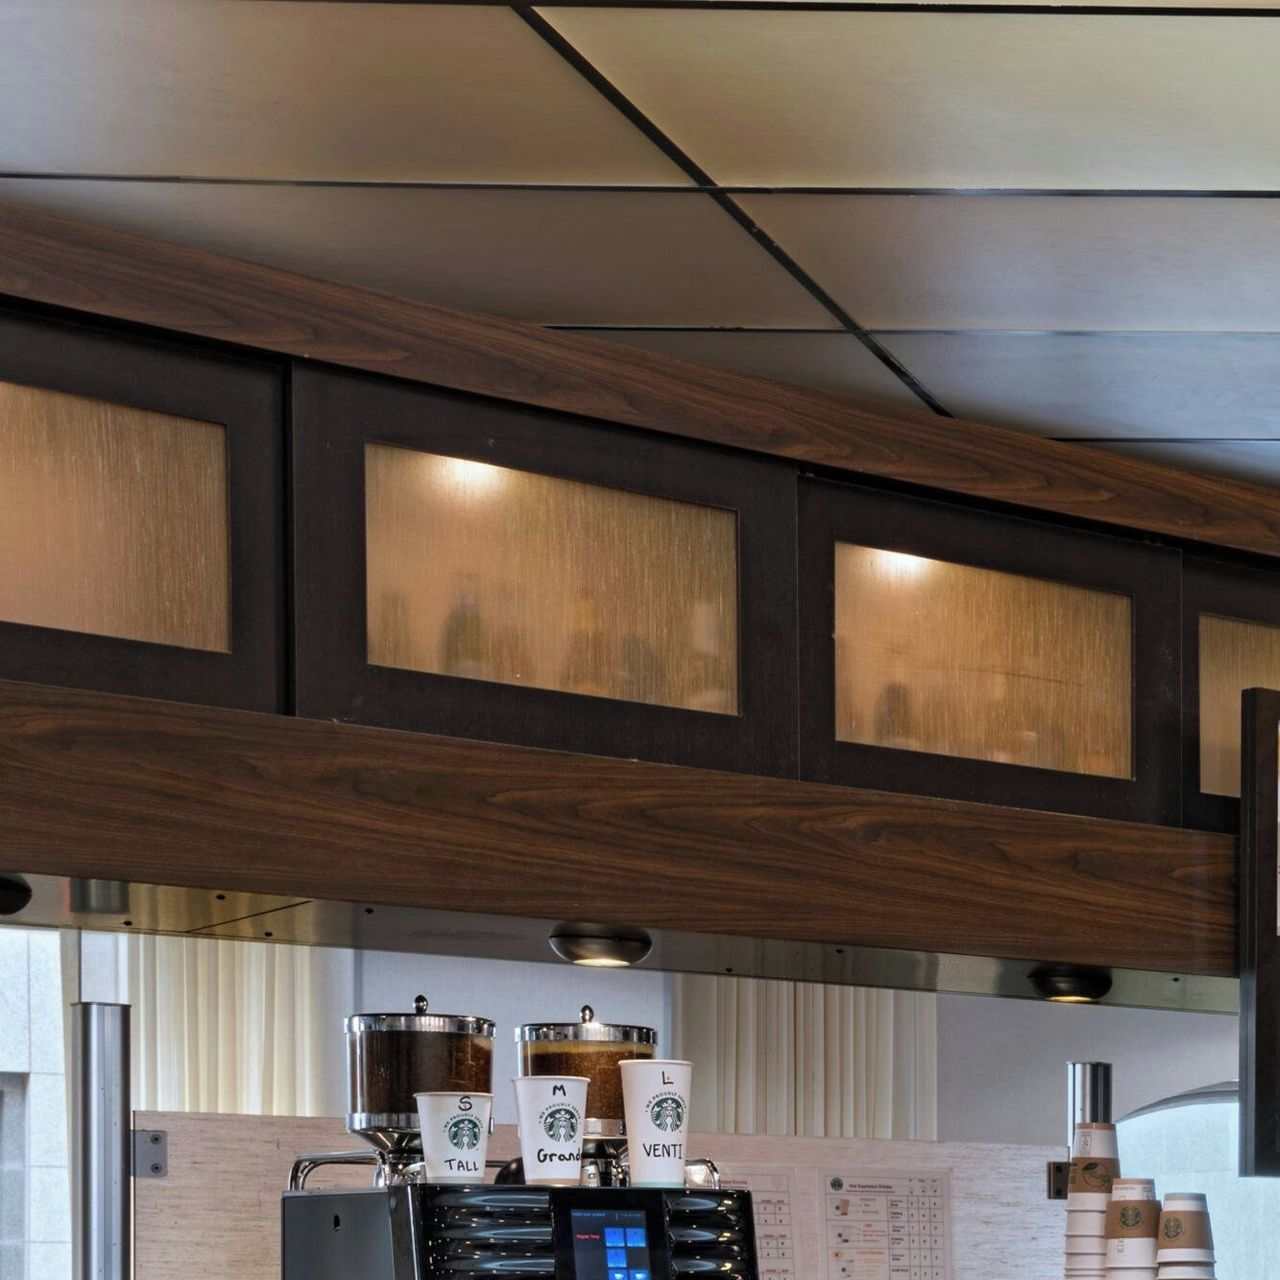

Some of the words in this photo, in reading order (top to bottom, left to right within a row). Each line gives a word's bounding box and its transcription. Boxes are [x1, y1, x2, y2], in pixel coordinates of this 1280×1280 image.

[661, 1070, 674, 1085] L
[552, 1084, 567, 1096] M
[458, 1095, 473, 1112] S
[642, 1142, 683, 1160] VENTI
[444, 1158, 479, 1172] TALL
